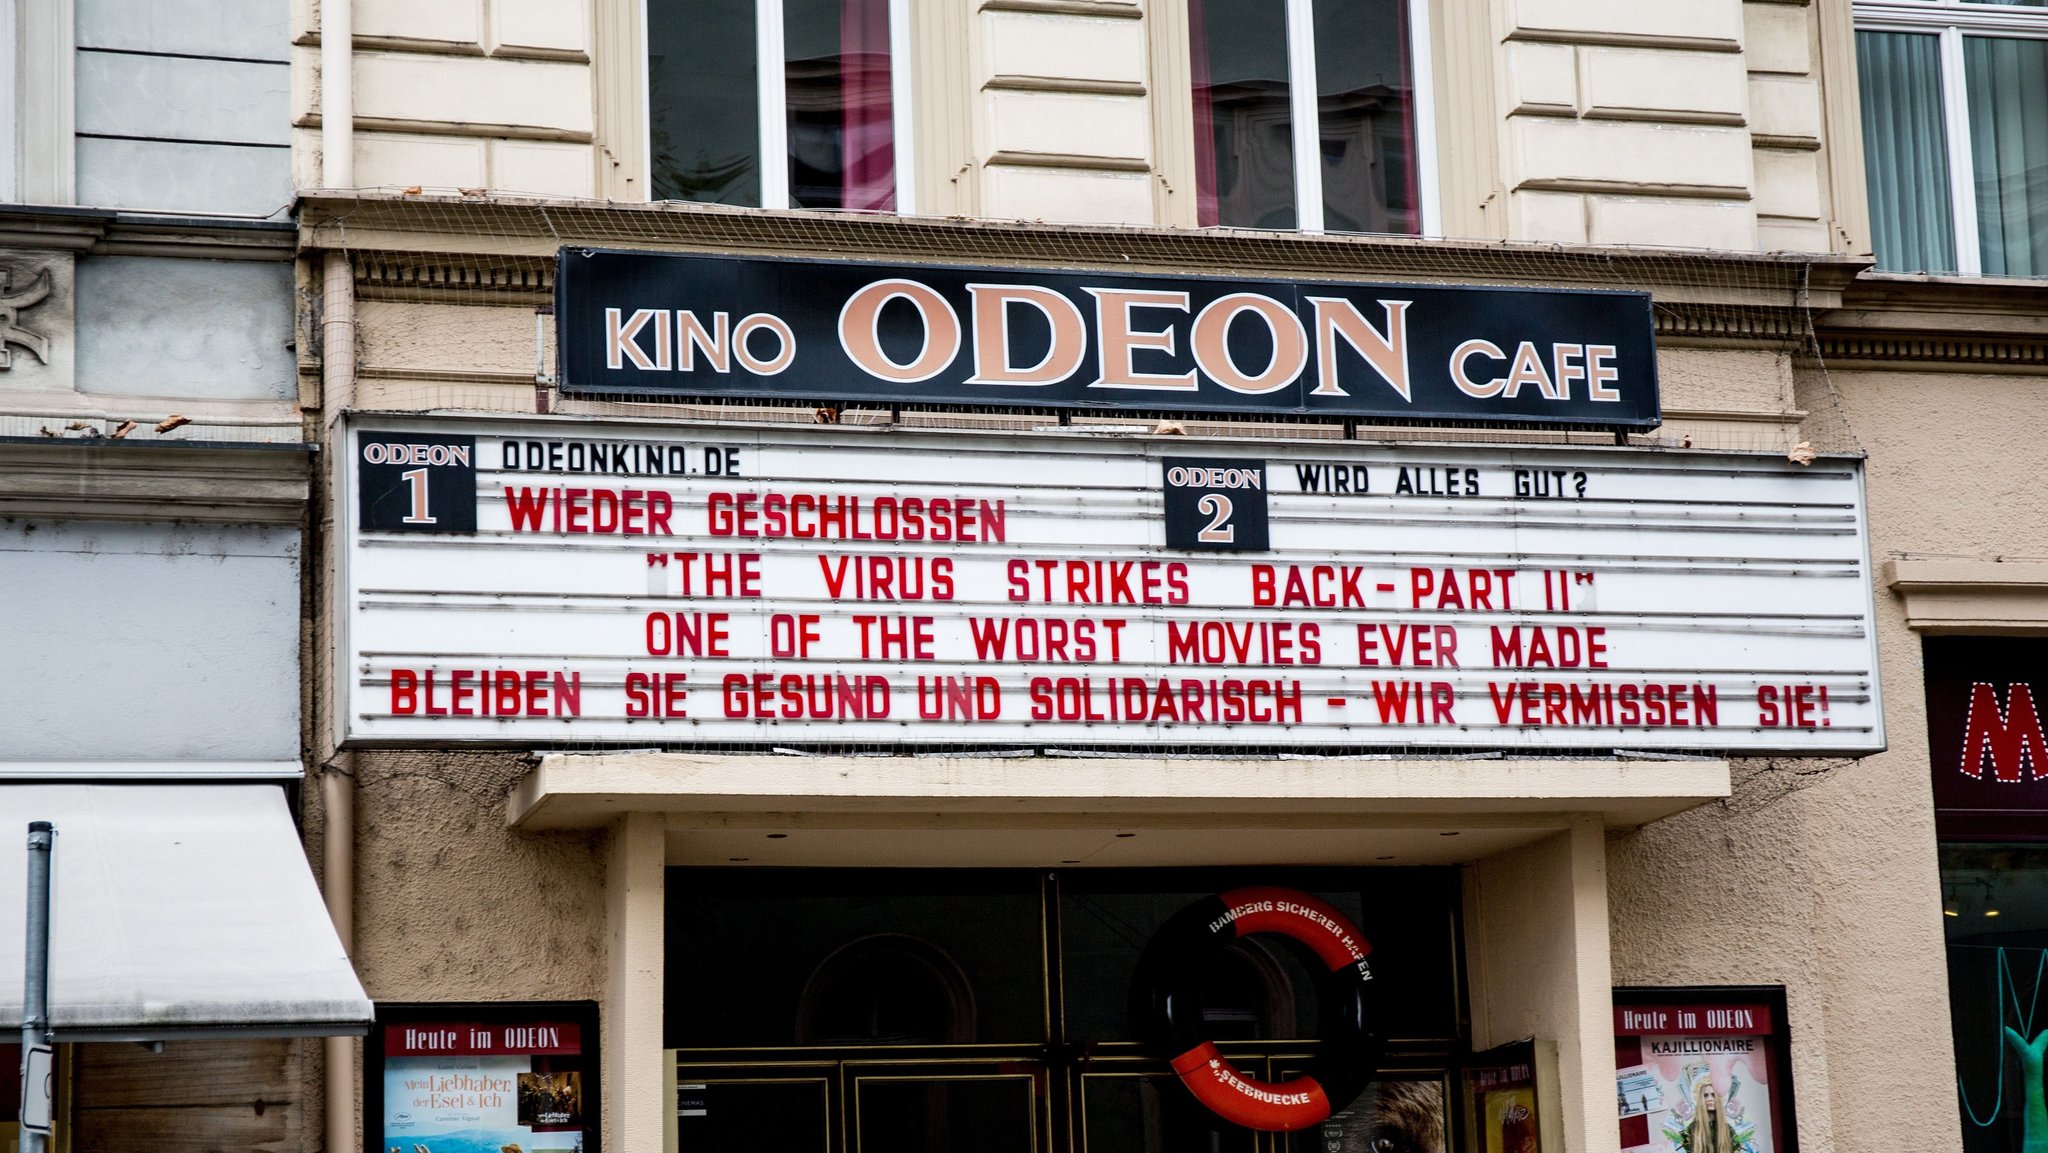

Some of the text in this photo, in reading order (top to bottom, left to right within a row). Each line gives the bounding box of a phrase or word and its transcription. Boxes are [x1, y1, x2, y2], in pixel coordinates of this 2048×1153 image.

[605, 277, 1622, 403] KINO ODEON CAFE
[363, 442, 471, 468] ODEON
[502, 440, 741, 477] ODEONKINO.DE
[401, 467, 438, 525] 1
[1167, 466, 1262, 490] ODEON
[1295, 464, 1588, 499] WIRD ALLES GUT?
[505, 486, 1006, 544] WIEDER GESCHLOSSEN
[1197, 493, 1235, 544] 2
[817, 554, 955, 601] VIRUS
[1007, 559, 1189, 605] STRIKES
[646, 611, 1608, 669] ONE OF THE WORST MOVIES EVER MADE
[390, 669, 581, 717] BLEIBEN
[625, 672, 687, 718] SIE
[722, 673, 891, 720] GESUND
[917, 675, 1002, 721] UND
[1030, 676, 1302, 723] SOLIDARISCH
[1371, 680, 1454, 725] WIR
[1488, 681, 1718, 726] VERMISSEN
[1757, 684, 1831, 727] SIE!
[1276, 901, 1345, 938] SICHERER
[1623, 1009, 1754, 1030] Heute im ODEON
[405, 1027, 560, 1050] Heute im ODEON
[1651, 1039, 1754, 1054] KAJILLIONAIRE
[413, 1093, 502, 1109] der Esel & Ich
[1220, 1069, 1311, 1105] SEEBRUECKE
